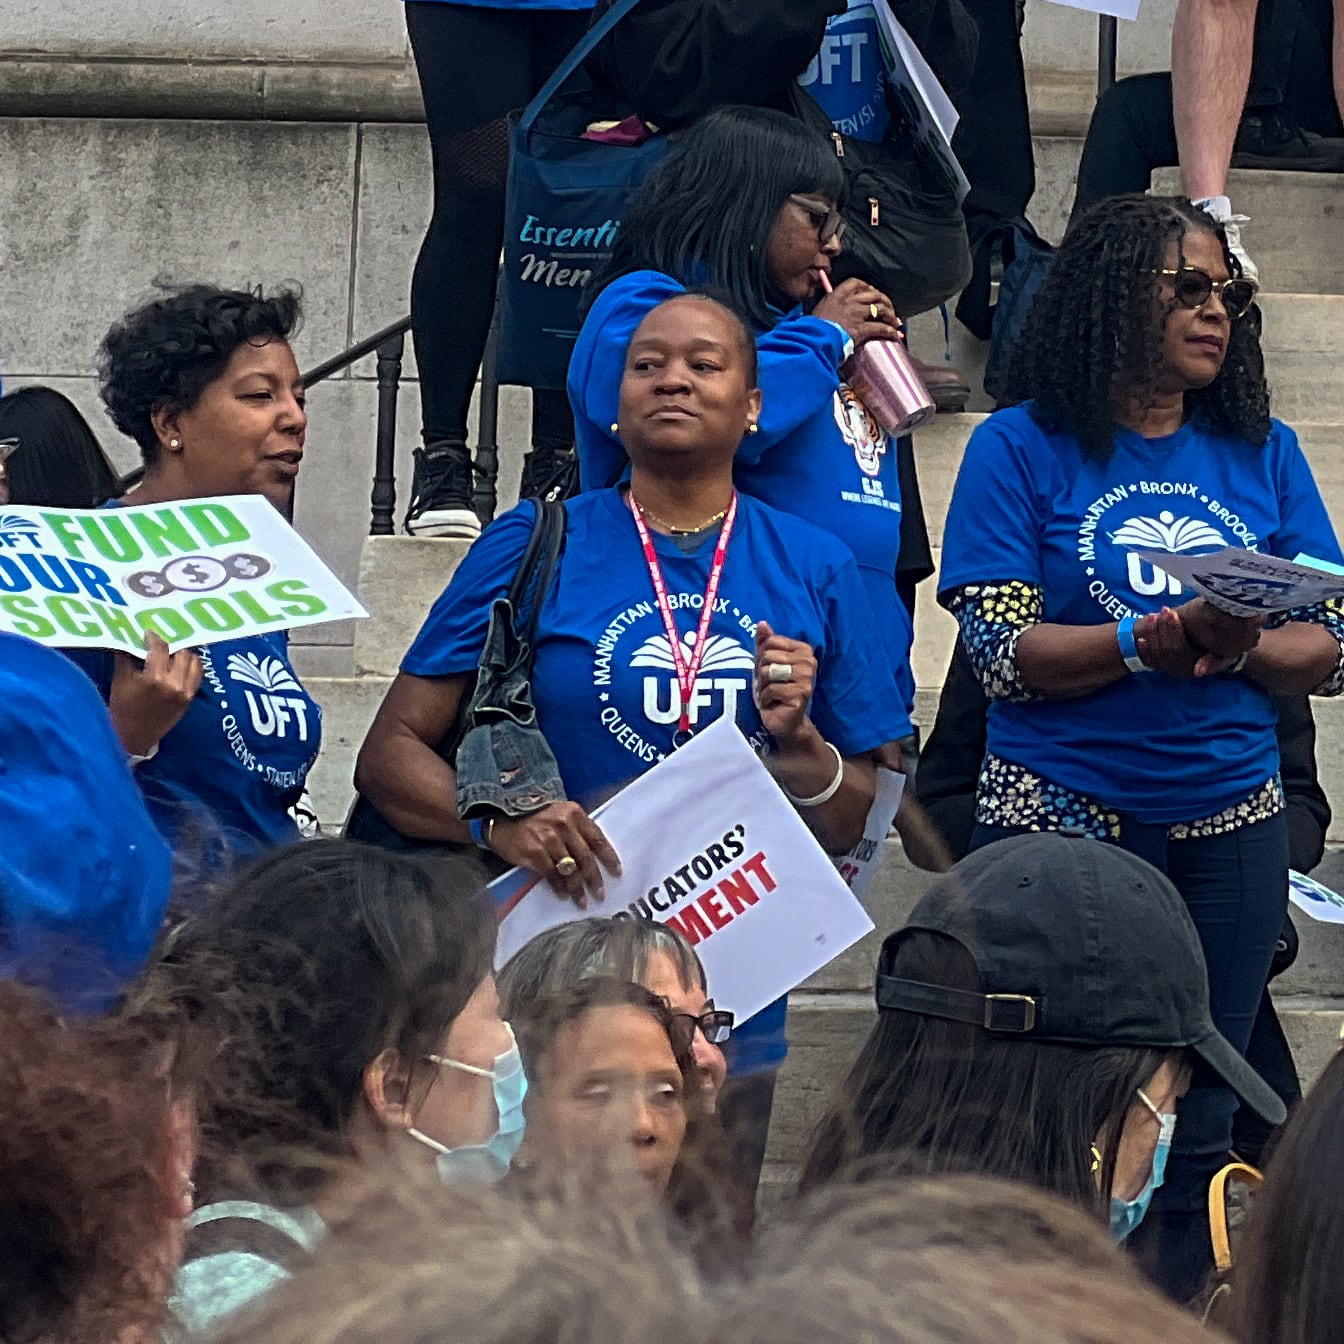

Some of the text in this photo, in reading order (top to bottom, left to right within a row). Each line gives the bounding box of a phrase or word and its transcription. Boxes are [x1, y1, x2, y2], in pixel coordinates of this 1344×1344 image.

[520, 214, 620, 248] Essenti
[1139, 480, 1198, 500] BRONX
[39, 503, 252, 563] FUND
[1, 579, 328, 651] SCHOOLS
[1088, 580, 1146, 622] QUEEN
[593, 593, 731, 685] MANHATTAN BROX
[244, 689, 307, 742] UFT
[643, 676, 747, 725] UFT
[222, 714, 257, 771] QUEENS
[600, 707, 657, 762] QUEENS
